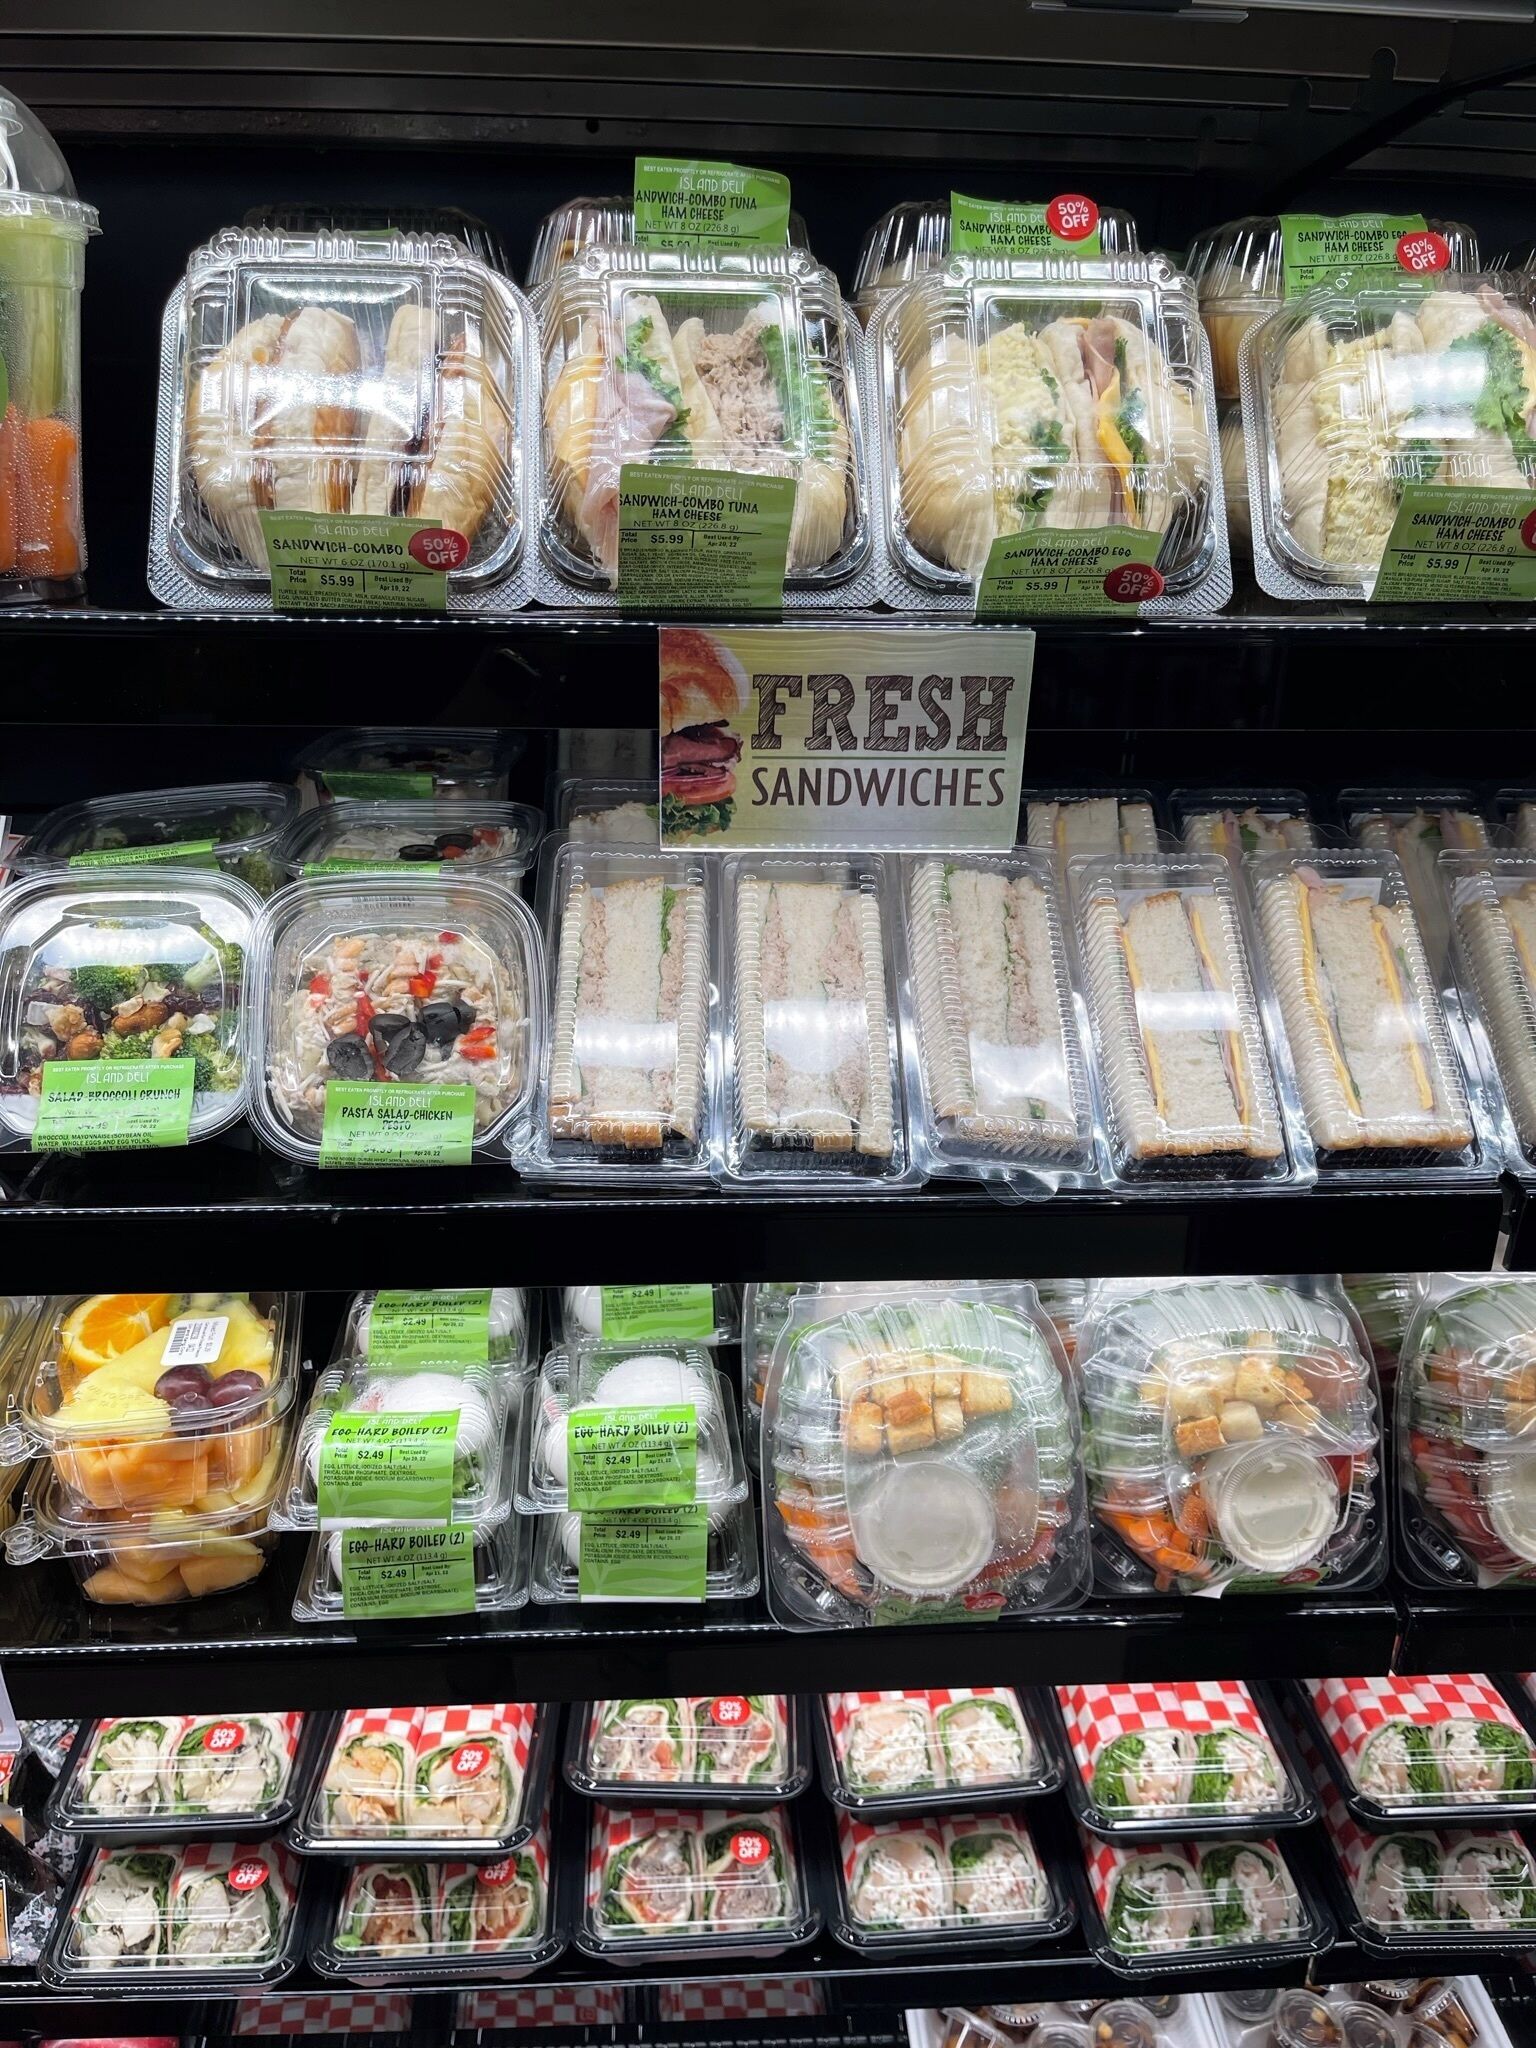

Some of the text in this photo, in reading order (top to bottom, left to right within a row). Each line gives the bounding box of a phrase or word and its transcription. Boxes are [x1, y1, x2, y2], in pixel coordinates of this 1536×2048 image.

[679, 176, 744, 194] ISLAND DELI
[636, 190, 757, 210] ANDWICH-COMBO TUNA
[661, 206, 724, 221] HAM CHEESE
[1058, 202, 1089, 216] 50%
[990, 212, 1026, 223] ISLAND
[1062, 214, 1090, 229] OFF
[645, 220, 728, 233] NET WT 8 OZ (226.8
[960, 220, 1052, 234] SANDWICH-COMBO
[1323, 220, 1384, 229] ISLAND DELI
[990, 235, 1052, 246] HAM CHEESE
[1298, 230, 1389, 242] SANDWICH-COMBO
[1324, 241, 1384, 253] HAM CHEESE
[1403, 238, 1433, 258] 50%
[1309, 252, 1390, 264] NET WT 8 OZ (226.8
[1411, 251, 1437, 271] OFF
[670, 483, 742, 500] ISLAND DELI
[728, 501, 758, 514] TUNA
[1447, 501, 1518, 516] ISLAND DELI
[652, 508, 722, 522] HAM CHEESE
[633, 520, 652, 528] NET
[656, 520, 671, 528] WT
[698, 521, 727, 530] (226.8
[1412, 514, 1516, 529] SANDWICH-COMBO
[314, 524, 390, 537] ISLAND DELI
[1436, 528, 1506, 542] HAM CHEESE
[422, 538, 458, 550] 50%
[650, 534, 684, 545] $5.99
[1036, 538, 1108, 548] ISLAND DELI
[272, 538, 404, 556] SANDWICH-COMBO
[1415, 540, 1507, 552] NET WT 8 OZ (226.8
[427, 550, 460, 564] OFF
[1004, 546, 1132, 560] SANDWICH-COMBO EGG
[300, 556, 396, 569] NET WT OZ (170.1
[1030, 556, 1099, 567] HAM CHEESE
[1426, 558, 1460, 570] $5.99
[1074, 566, 1102, 575] (226.8
[320, 574, 354, 587] $5.99
[1120, 570, 1154, 586] 50%
[1025, 582, 1058, 591] $5.99
[1118, 583, 1151, 598] OFF
[751, 674, 1015, 752] FRESH
[751, 766, 1006, 806] SANDWICHES
[86, 1071, 149, 1084] ISLAND DELI
[140, 1088, 180, 1100] CRUNCH
[369, 1096, 430, 1108] ISLAND DELI
[342, 1106, 452, 1120] PASTA SALAD-CHICKEN
[382, 1121, 412, 1130] PESTO
[632, 1288, 654, 1298] $2.49
[402, 1317, 426, 1326] $2.49
[332, 1428, 389, 1436] EGG-HARD
[392, 1427, 429, 1436] BOILED
[574, 1421, 688, 1438] EGG-HARD BOILED (2)
[640, 1440, 661, 1448] (113.4
[358, 1450, 384, 1460] $2.49
[606, 1455, 631, 1466] $2.49
[684, 1505, 698, 1514] (2)
[616, 1530, 640, 1539] $2.49
[349, 1532, 464, 1554] EGG-HARD BOILED (2)
[381, 1569, 406, 1580] $2.49
[719, 1701, 742, 1712] 50%
[719, 1711, 741, 1720] OFF
[213, 1728, 237, 1738] 50%
[210, 1738, 234, 1748] OFF
[460, 1750, 484, 1760] 50%
[456, 1760, 480, 1771] OFF
[738, 1836, 762, 1848] 50%
[738, 1848, 762, 1858] OFF
[239, 1863, 263, 1875] 50%
[484, 1870, 508, 1880] OFF
[235, 1873, 260, 1884] OFF
